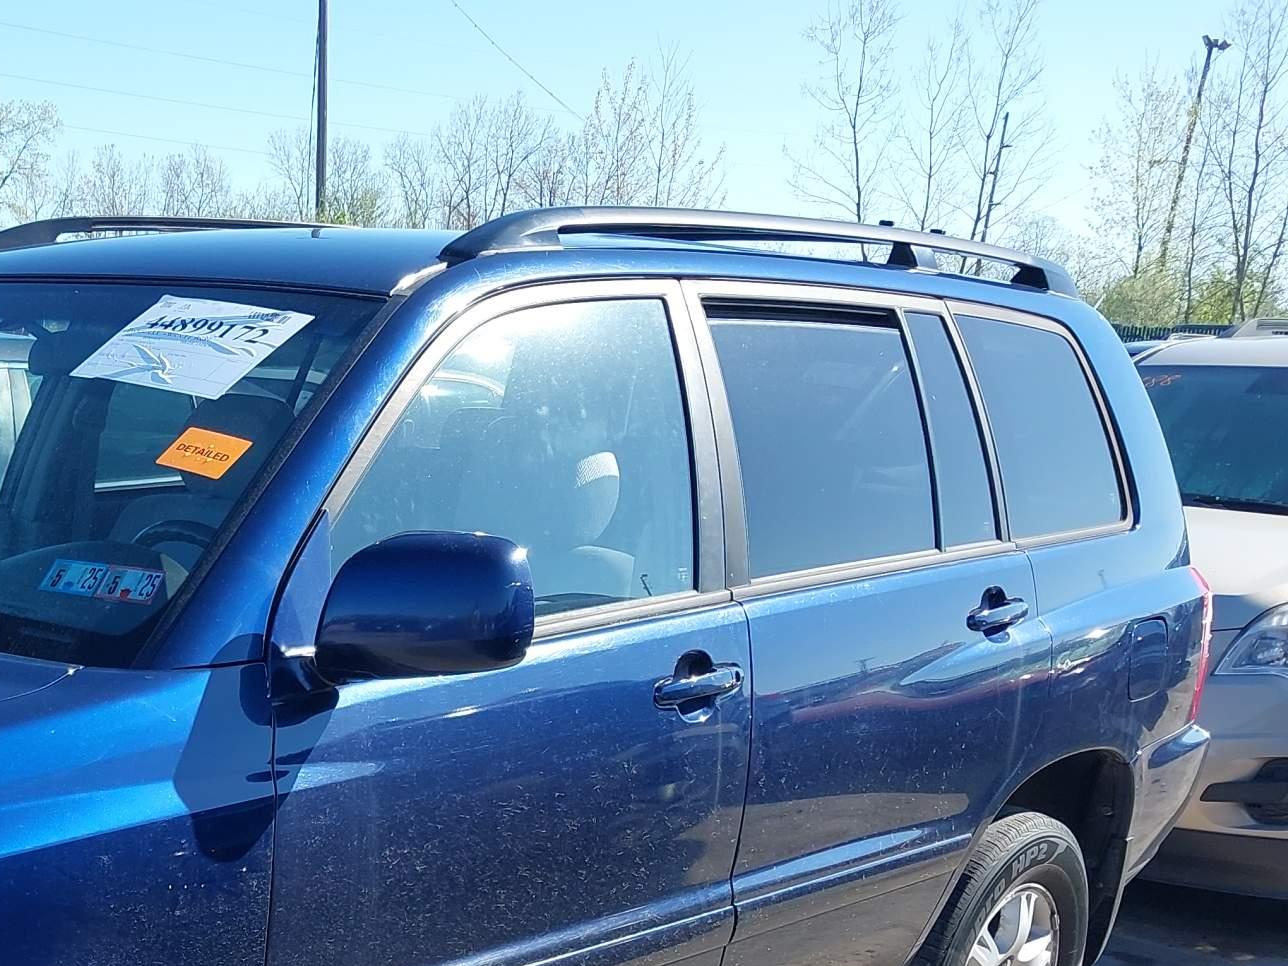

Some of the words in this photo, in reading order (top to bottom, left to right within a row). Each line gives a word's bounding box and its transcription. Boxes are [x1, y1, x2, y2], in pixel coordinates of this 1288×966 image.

[145, 315, 271, 344] 44899172
[175, 443, 230, 462] DETAILED
[1011, 842, 1049, 876] HP2
